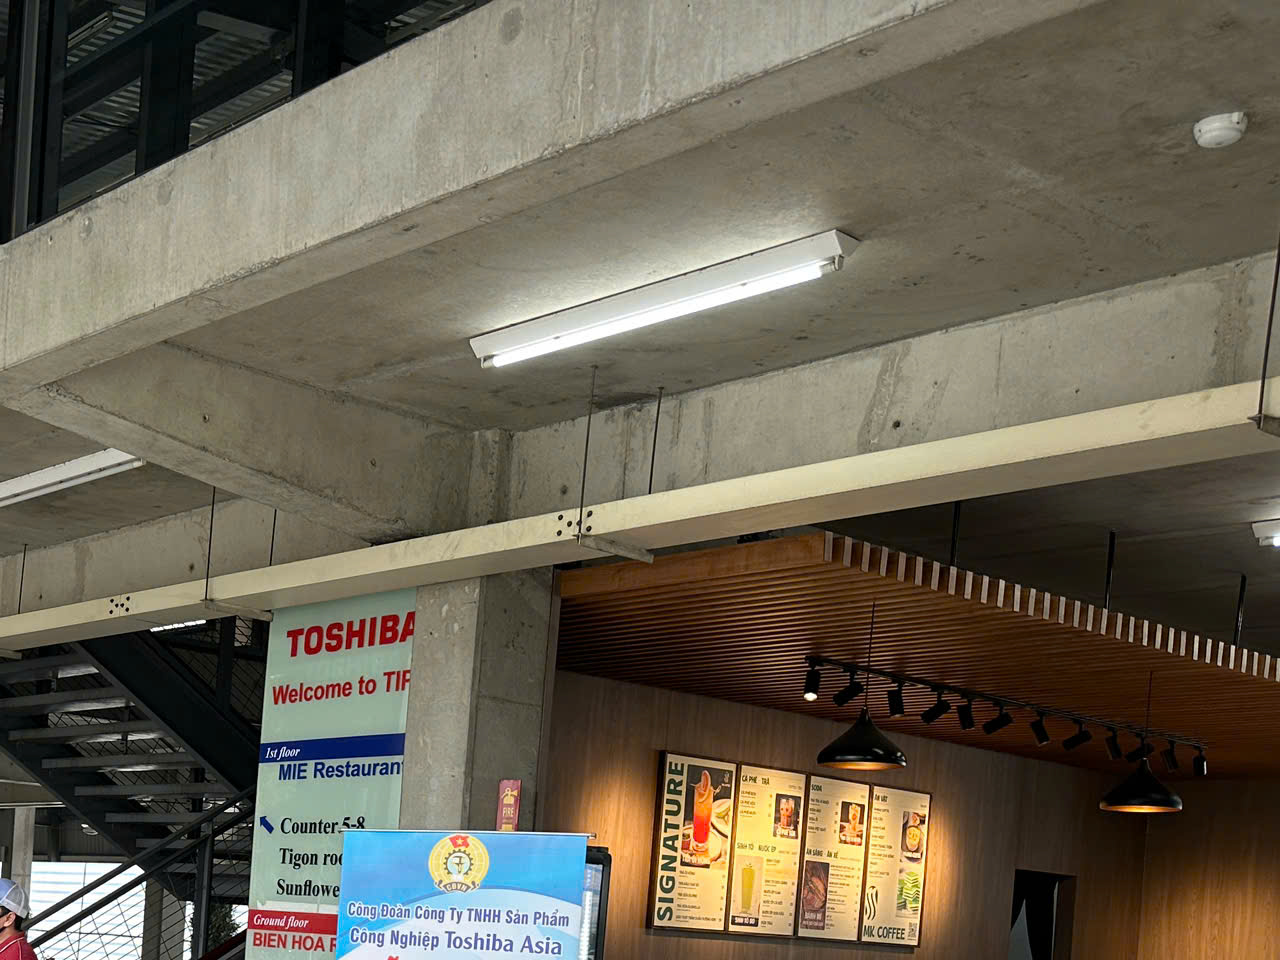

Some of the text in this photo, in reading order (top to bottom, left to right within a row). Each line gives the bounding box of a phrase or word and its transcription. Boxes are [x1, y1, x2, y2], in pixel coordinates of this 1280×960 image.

[286, 611, 416, 657] TOSHIBA
[273, 682, 352, 705] Welcome
[358, 676, 376, 695] to
[265, 746, 300, 761] 1st floor
[278, 762, 308, 781] MIE
[502, 807, 514, 818] FIRE
[280, 817, 338, 835] Counter
[657, 761, 685, 921] SIGNATURE
[279, 848, 318, 870] Tigon
[276, 878, 340, 898] Sunflowe
[253, 914, 309, 929] Ground floor
[348, 902, 570, 927] Công Đoàn Công Ty TNHH Sản Phẩm
[253, 932, 286, 949] BIEN
[292, 935, 325, 952] HOA
[350, 928, 384, 948] Công
[390, 930, 440, 952] Nghiệp
[445, 931, 514, 952] Toshiba
[520, 935, 562, 955] Asia
[863, 925, 906, 940] MK COFFEE
